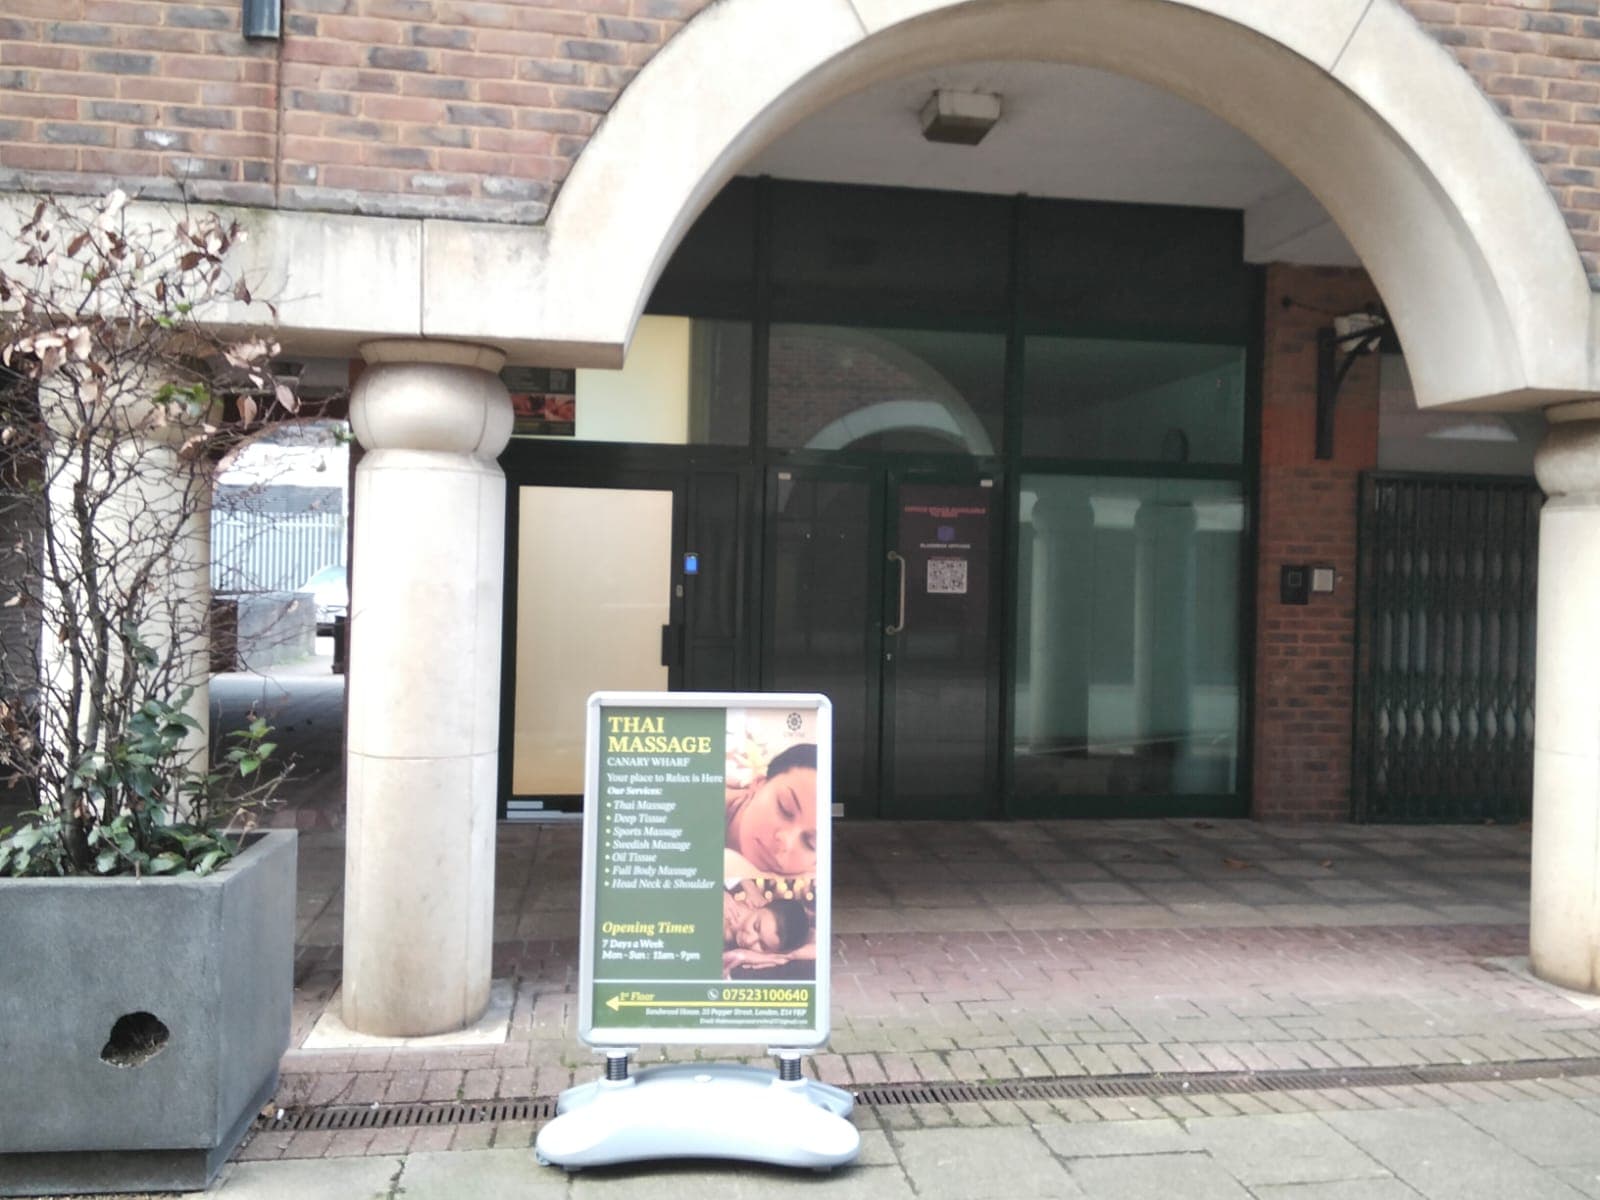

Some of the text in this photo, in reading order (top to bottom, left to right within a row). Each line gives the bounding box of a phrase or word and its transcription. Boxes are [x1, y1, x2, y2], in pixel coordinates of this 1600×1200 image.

[608, 716, 664, 733] THAI
[607, 736, 711, 753] MASSAGE
[606, 757, 691, 767] CANARY WHARF
[606, 773, 724, 784] Your place to Relax is Here
[607, 787, 663, 796] Our Services:
[613, 800, 677, 812] Thai Massage
[613, 813, 668, 825] Deep Tissue
[612, 827, 684, 839] Sports Massage
[612, 840, 691, 852] Swedish Massage
[611, 852, 658, 862] Oil Tissue
[611, 865, 698, 878] Full Body Massage
[611, 878, 716, 889] Head Neck & Shoulder
[602, 921, 695, 936] Opening Times
[602, 939, 609, 949] 7
[610, 939, 632, 949] Days
[639, 939, 665, 949] Week
[602, 950, 623, 960] Mon
[629, 950, 646, 960] Sun
[680, 950, 701, 962] 9pm
[630, 991, 656, 1001] Floor
[722, 988, 809, 1001] 07523100640
